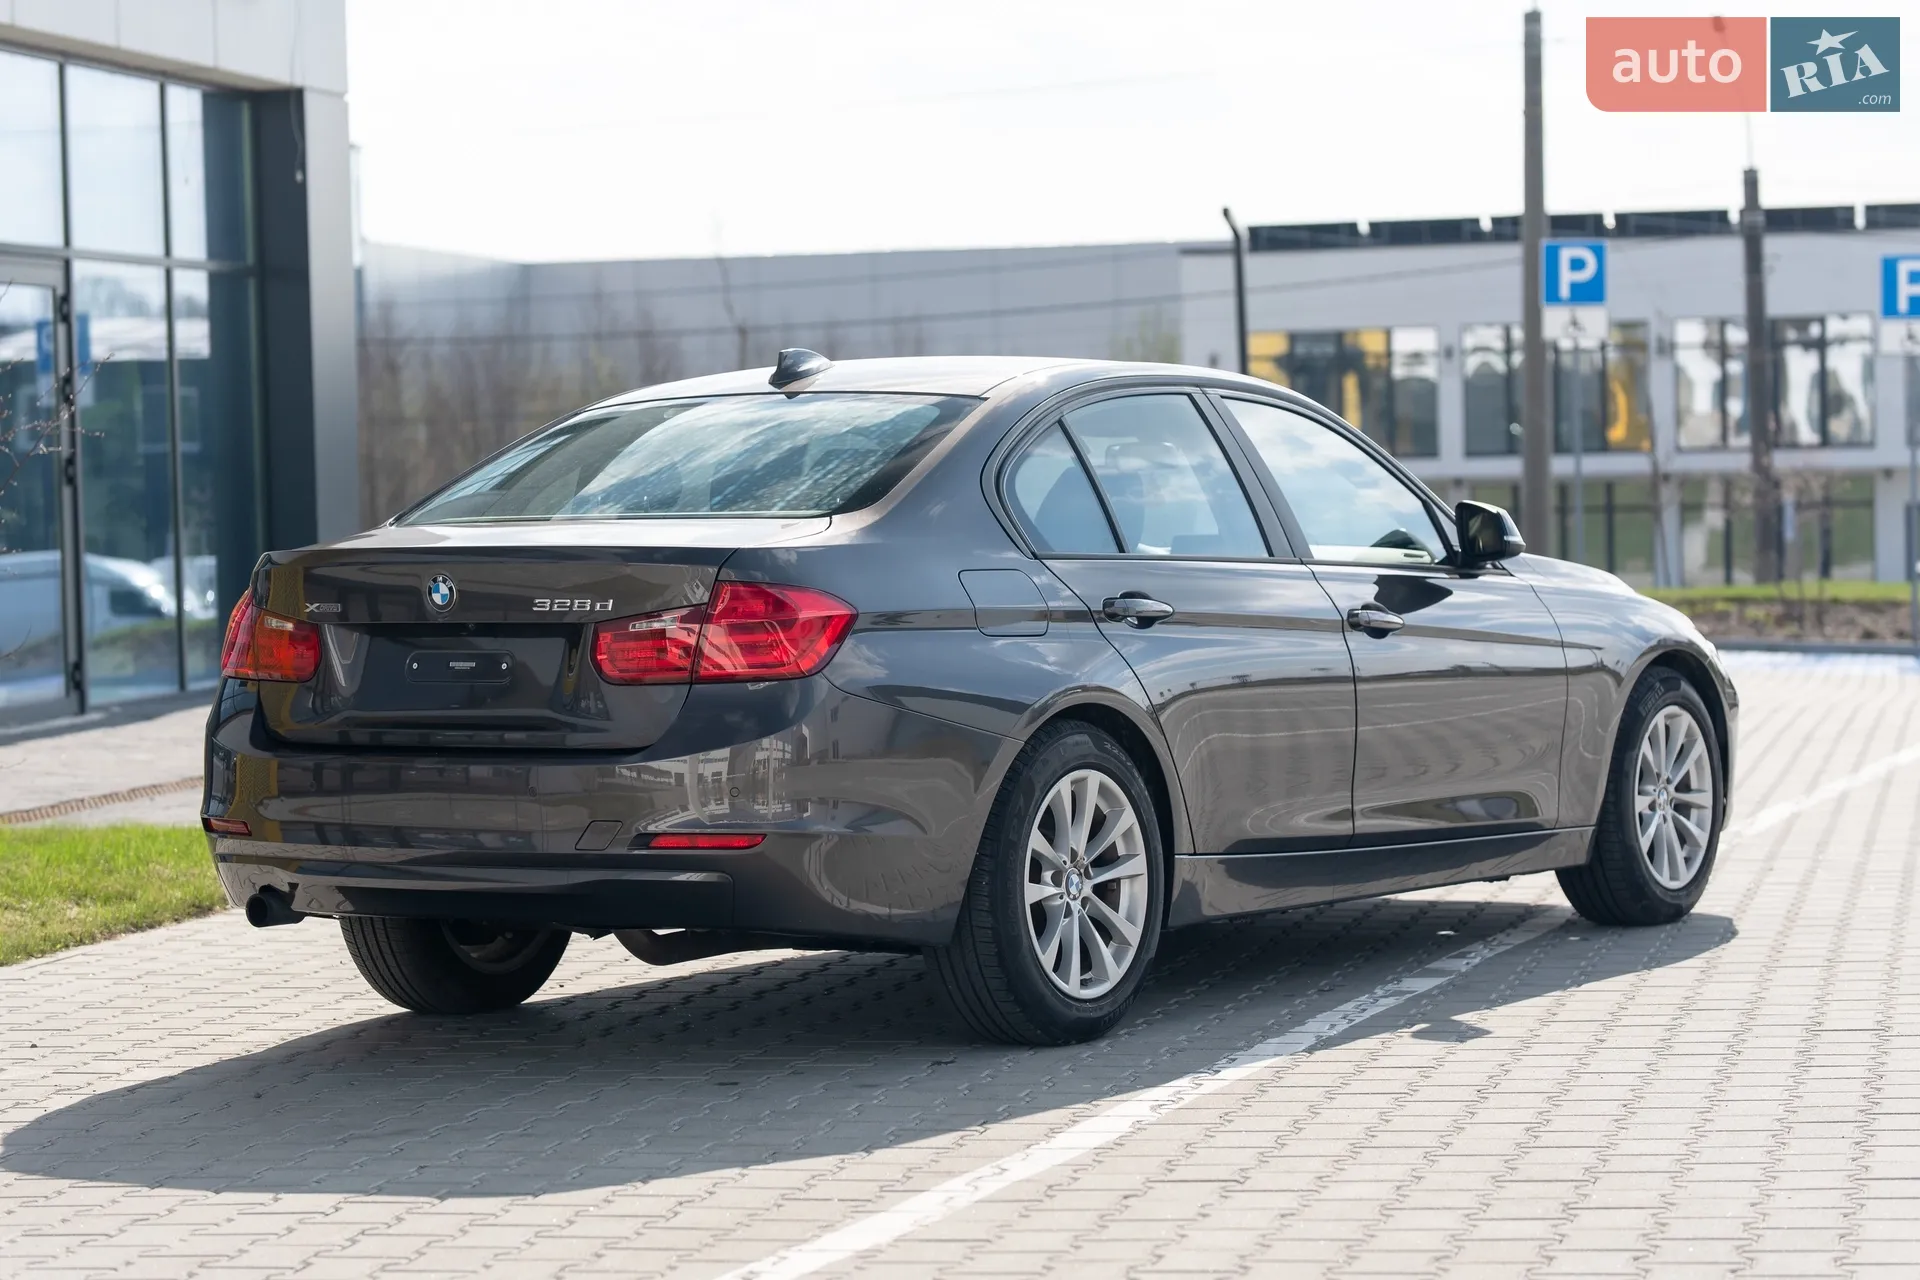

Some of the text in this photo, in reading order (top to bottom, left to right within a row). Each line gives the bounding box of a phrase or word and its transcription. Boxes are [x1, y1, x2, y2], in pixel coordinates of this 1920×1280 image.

[1558, 246, 1598, 301] P
[429, 576, 452, 588] BMW
[532, 599, 613, 611] 328d
